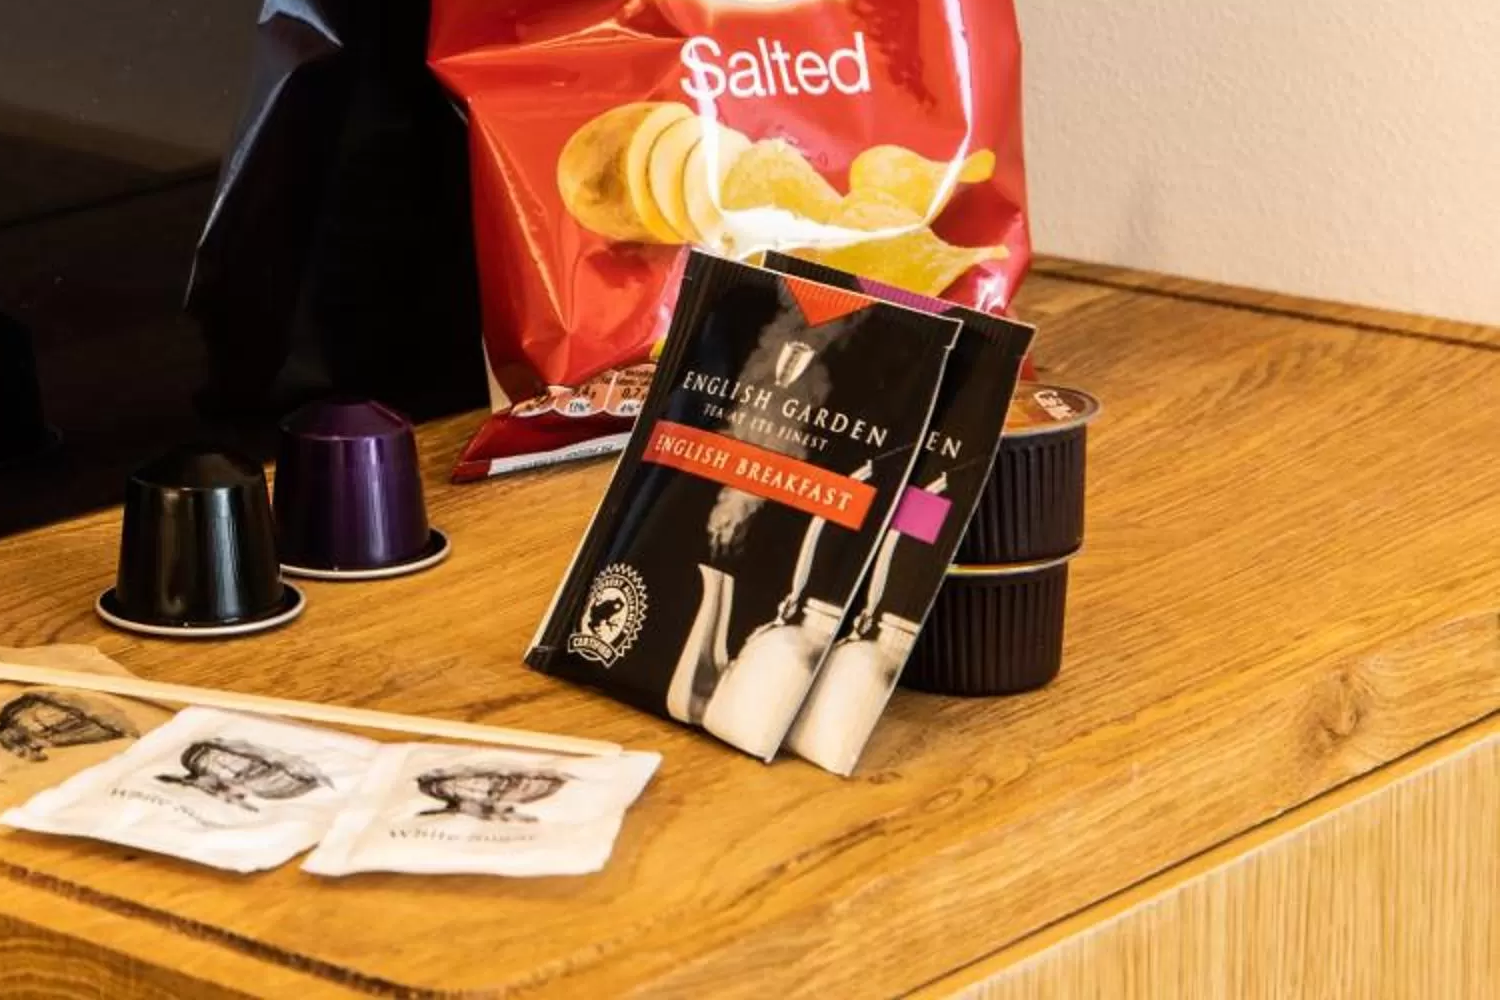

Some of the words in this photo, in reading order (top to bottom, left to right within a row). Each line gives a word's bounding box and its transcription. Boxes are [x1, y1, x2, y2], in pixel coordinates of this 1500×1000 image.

[679, 31, 871, 97] Salted
[683, 370, 773, 411] ENGLISH
[781, 398, 888, 448] GARDEN
[703, 402, 725, 419] TEA
[729, 410, 746, 426] AT
[749, 416, 773, 436] ITS
[776, 423, 830, 451] FINEST
[655, 432, 731, 469] ENGLISH
[735, 458, 853, 513] BREAKFAST
